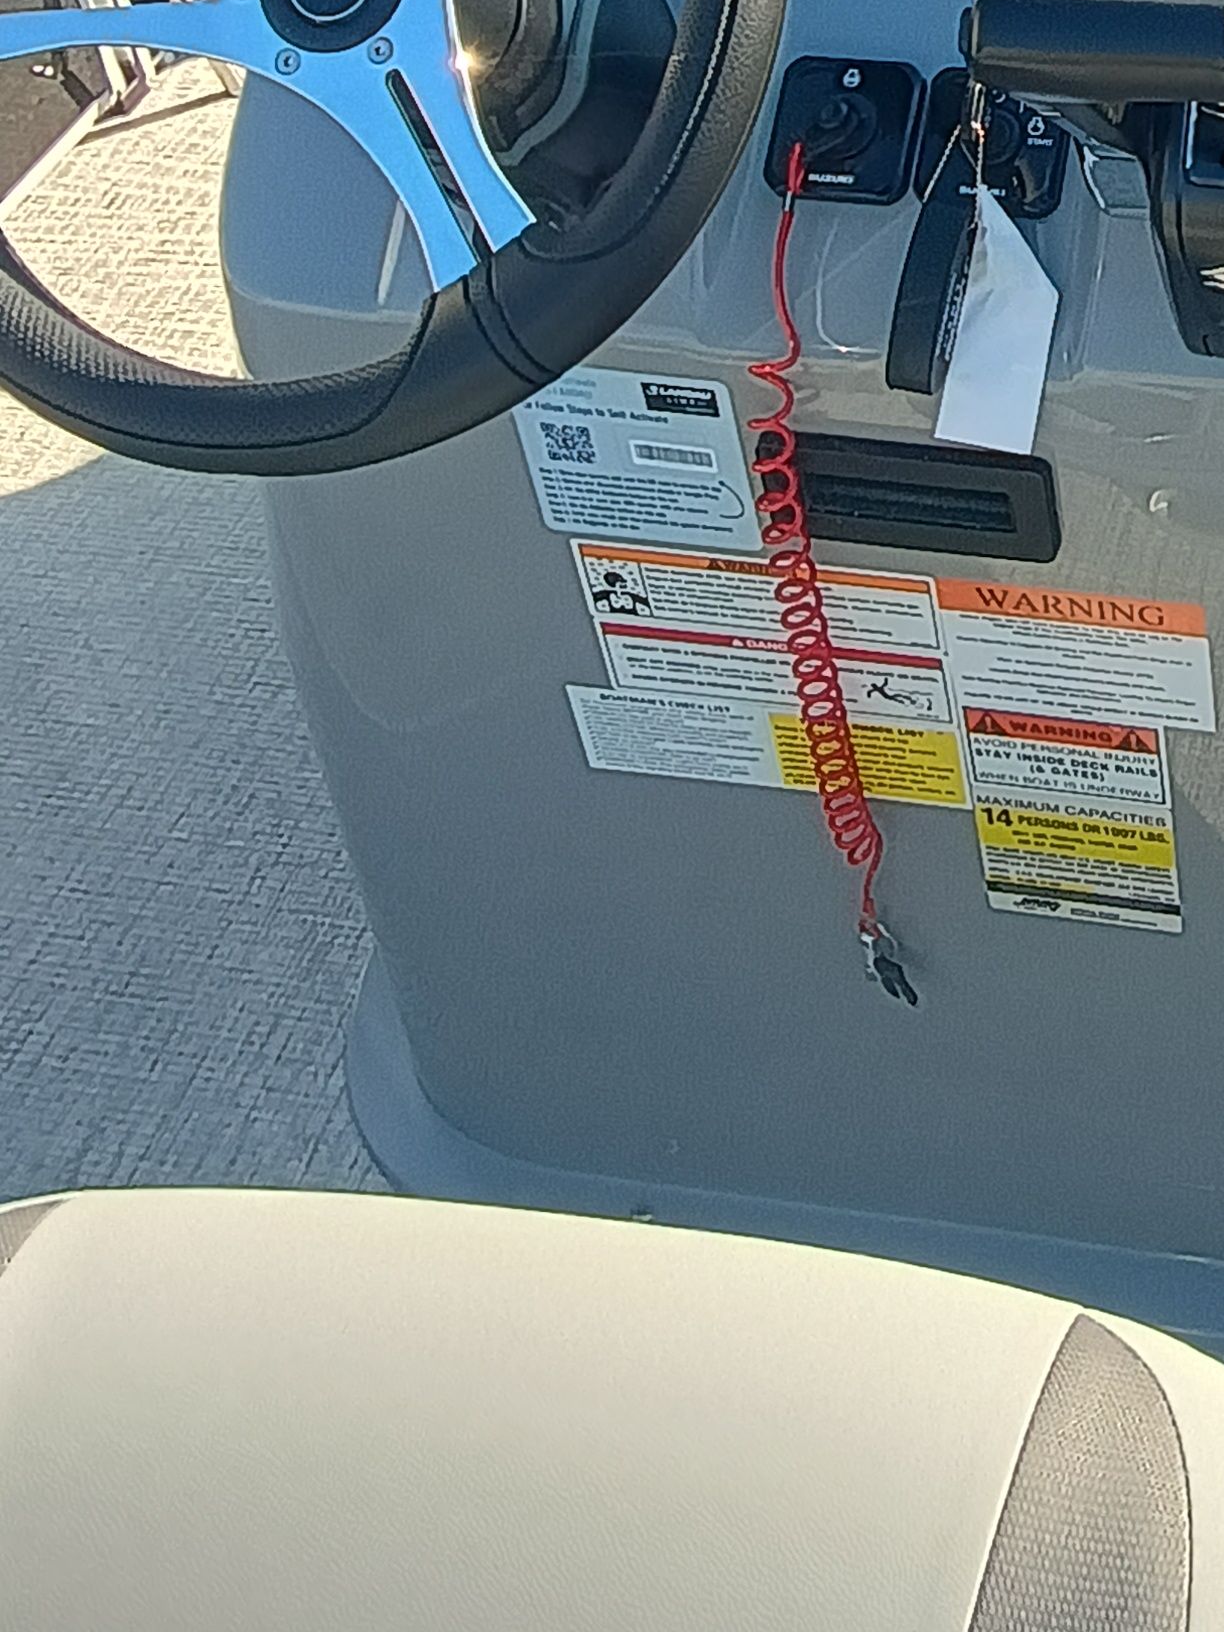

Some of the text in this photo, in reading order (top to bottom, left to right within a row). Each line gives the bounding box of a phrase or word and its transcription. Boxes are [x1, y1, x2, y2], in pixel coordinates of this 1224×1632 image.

[975, 587, 1165, 626] WARNING
[1008, 720, 1113, 743] WARNING
[973, 737, 1018, 750] AVOID
[1021, 741, 1100, 759] PERSONAL
[974, 747, 1158, 778] STAY INSIDE DECK RAILS
[1051, 767, 1105, 782] GATES)
[976, 795, 1167, 827] MAXIMUM CAPACITIES
[981, 808, 1014, 827] 14
[1018, 815, 1079, 832] PERSONS
[1082, 824, 1100, 835] OR
